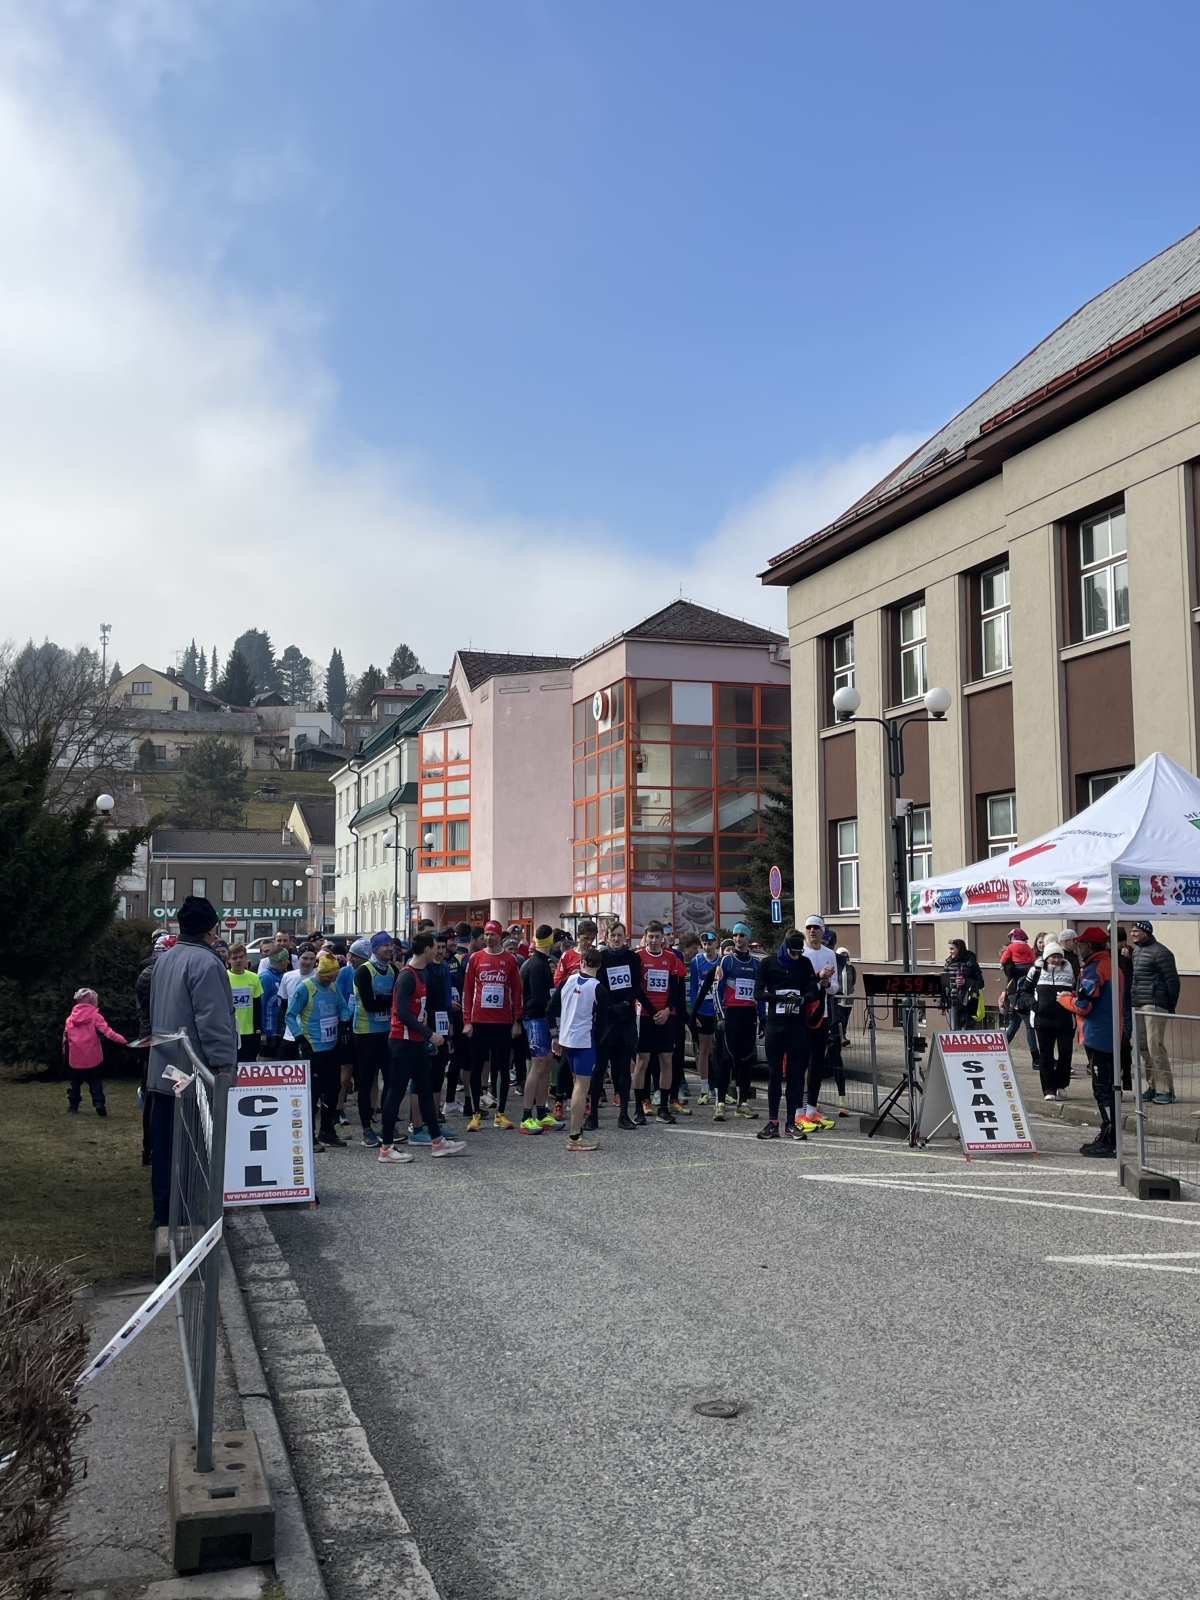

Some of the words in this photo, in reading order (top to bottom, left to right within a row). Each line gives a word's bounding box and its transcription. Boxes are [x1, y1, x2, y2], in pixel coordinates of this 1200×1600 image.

[965, 879, 1009, 897] MARATON
[1033, 898, 1060, 906] AGENTURA
[222, 908, 303, 917] ZELENINA
[479, 970, 507, 982] Carla
[610, 974, 631, 986] 260
[649, 978, 667, 988] 333
[738, 986, 753, 996] 317
[233, 995, 250, 1004] 347
[485, 994, 499, 1004] 49
[438, 1020, 449, 1031] 118
[325, 1027, 337, 1037] 114
[939, 1034, 1003, 1046] MARATON
[237, 1065, 305, 1078] ARATON
[962, 1060, 999, 1140] START
[968, 1142, 1031, 1150] www.maratonstav.cz
[227, 1188, 307, 1200] www.maratonstav.cz
